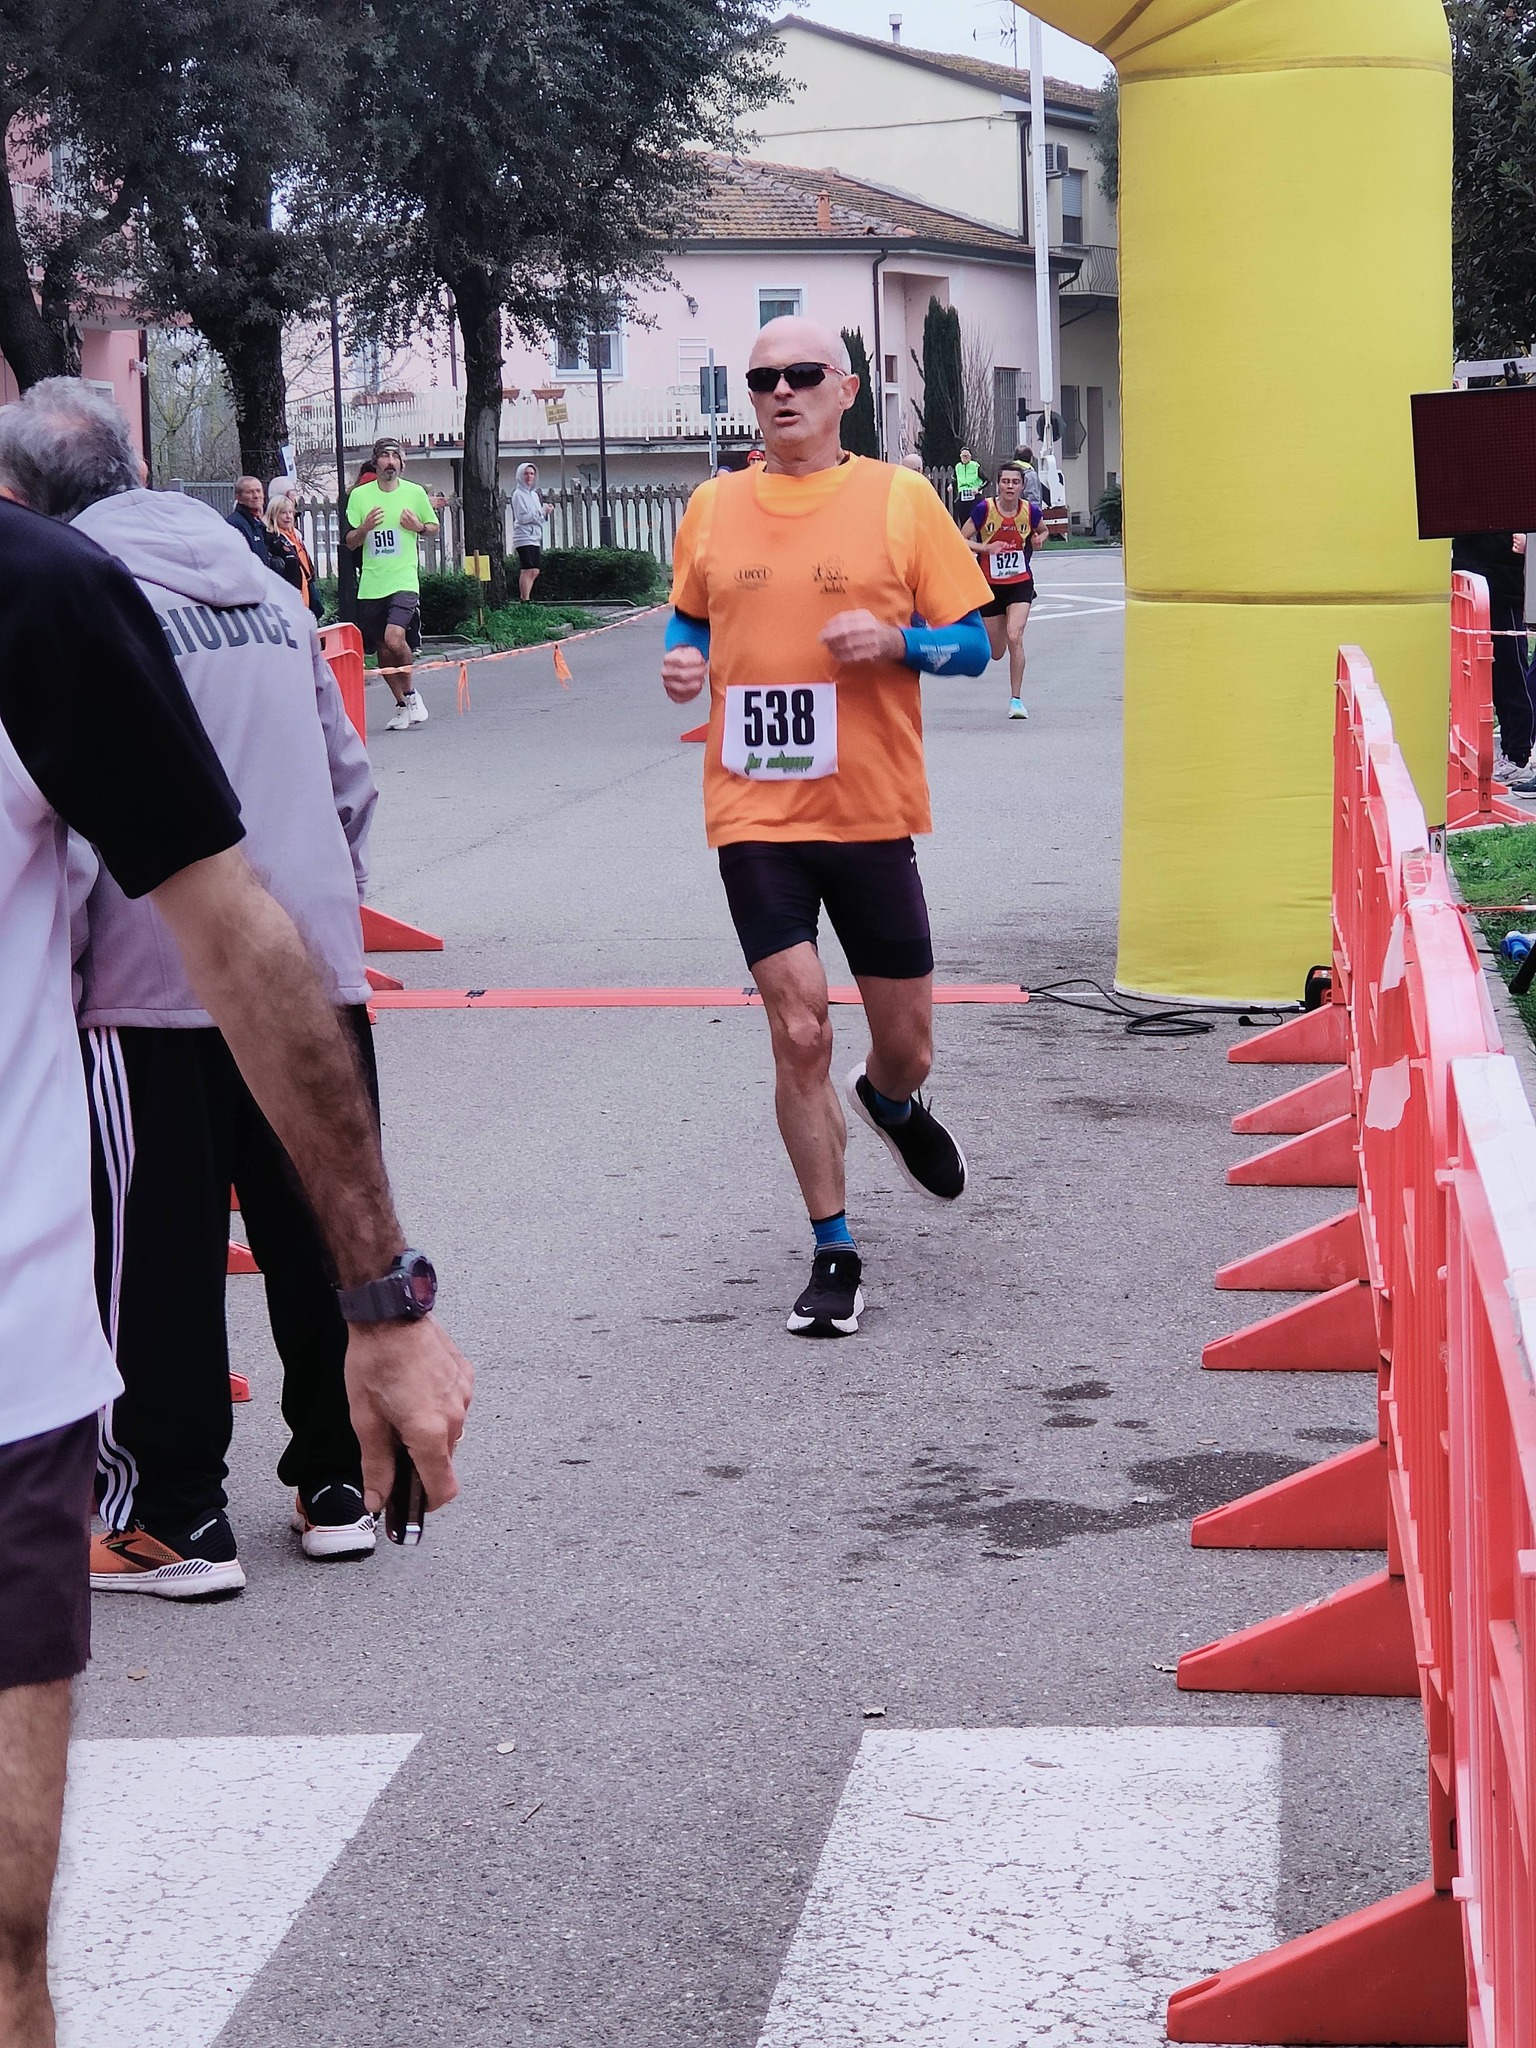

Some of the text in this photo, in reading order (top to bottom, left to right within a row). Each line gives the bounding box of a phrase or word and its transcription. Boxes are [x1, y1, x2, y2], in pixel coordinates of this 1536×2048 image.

[374, 530, 395, 547] 519
[996, 552, 1019, 569] 522
[744, 689, 815, 747] 538
